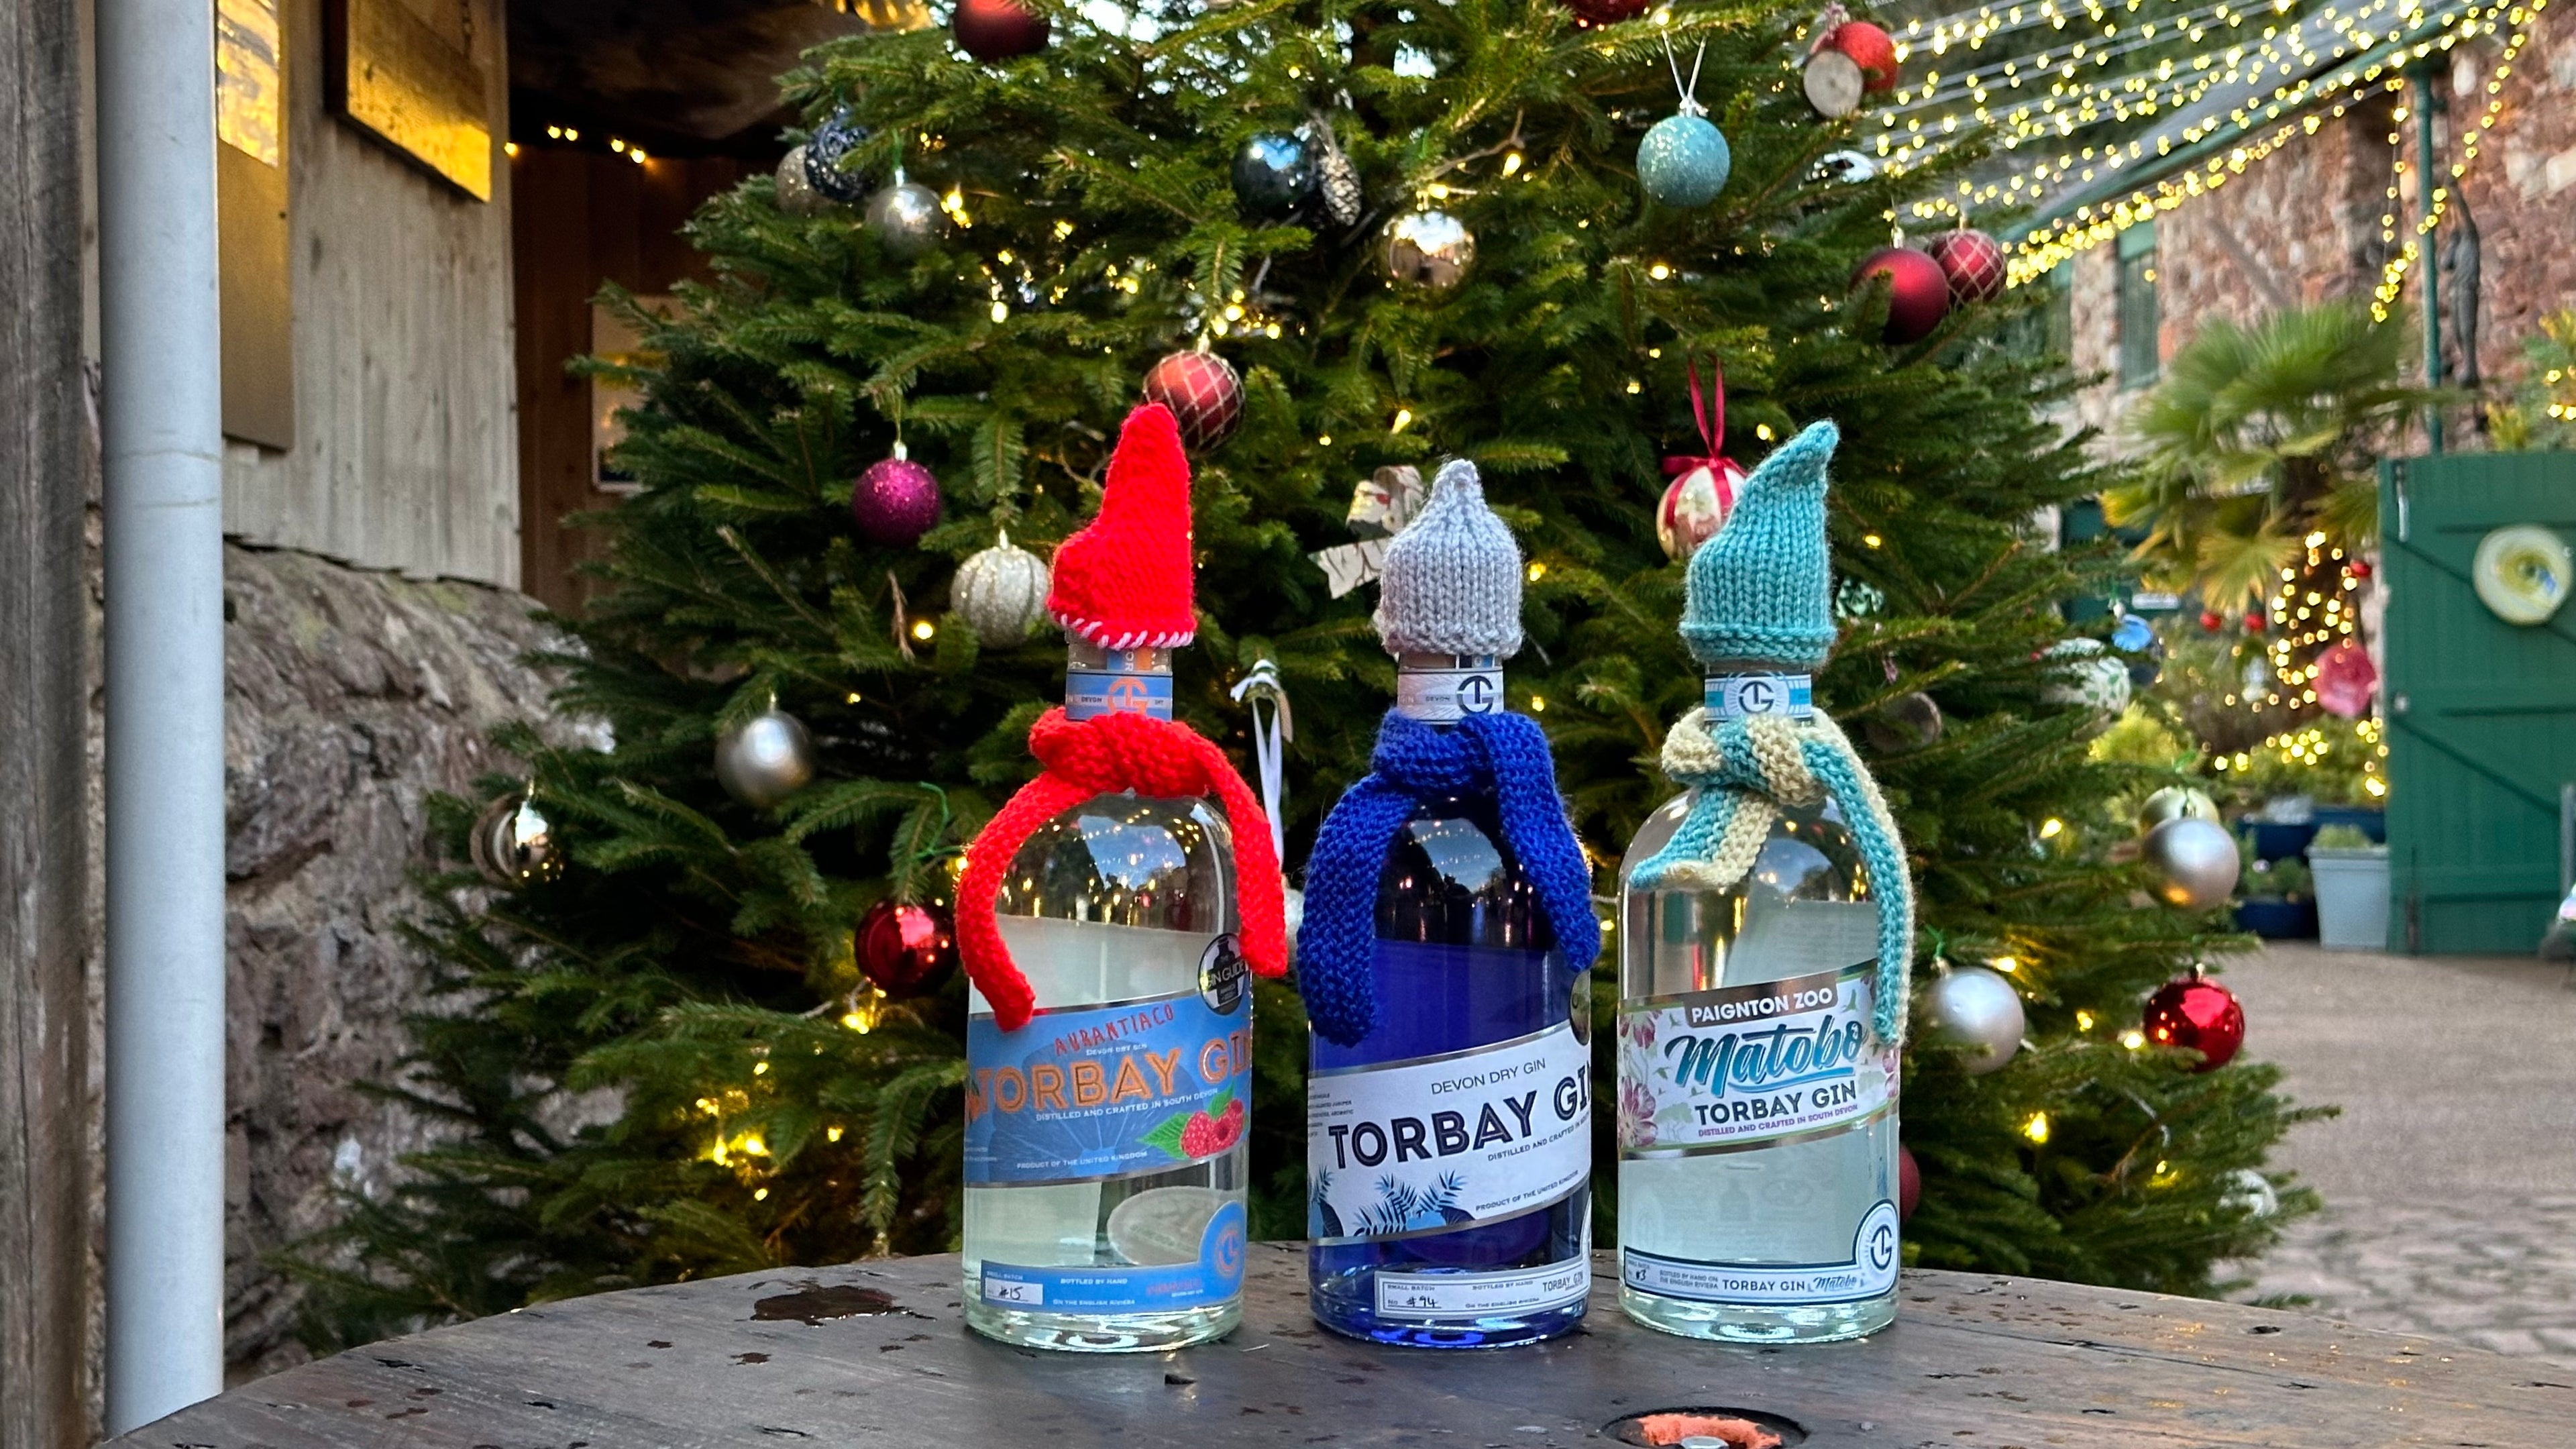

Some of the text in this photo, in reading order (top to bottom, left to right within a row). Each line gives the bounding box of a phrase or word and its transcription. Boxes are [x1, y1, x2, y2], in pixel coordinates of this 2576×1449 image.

[1691, 987, 1833, 1024] PAIGNTON ZOO
[1055, 1004, 1174, 1057] AURANTIACO
[1085, 1046, 1114, 1057] DEVON
[1664, 1014, 1864, 1099] Matobo
[975, 1048, 1181, 1113] TORBAY
[1431, 1057, 1546, 1095] DEVON DRY GIN
[1036, 1087, 1219, 1122] DISTILLED AND CRAFTED IN SOUTH DEVON
[1695, 1079, 1857, 1126] TORBAY GIN
[1328, 1090, 1538, 1169] TORBAY
[1698, 1103, 1858, 1138] DISTILLED AND CRAFTED IN SOUTH DEVON
[1016, 1150, 1148, 1169] PRODUCT OF THE UNITED KINGDOM
[1487, 1144, 1531, 1162] DISTILLED
[1532, 1138, 1548, 1150] AND
[1549, 1124, 1574, 1143] CRAFTED
[1475, 1169, 1579, 1212] PRODUCT OF THE UNITED KINGDOM
[1472, 1282, 1504, 1291] BOTTLED
[1543, 1276, 1571, 1293] TORBAY
[1573, 1271, 1584, 1285] GIN
[1659, 1269, 1680, 1279] BOTTLED
[1689, 1273, 1707, 1282] HAND
[1694, 1281, 1719, 1289] RIVIERA
[1721, 1279, 1806, 1292] TORBAY GIN
[1812, 1274, 1858, 1293] Matobo
[1053, 1298, 1064, 1306] ON
